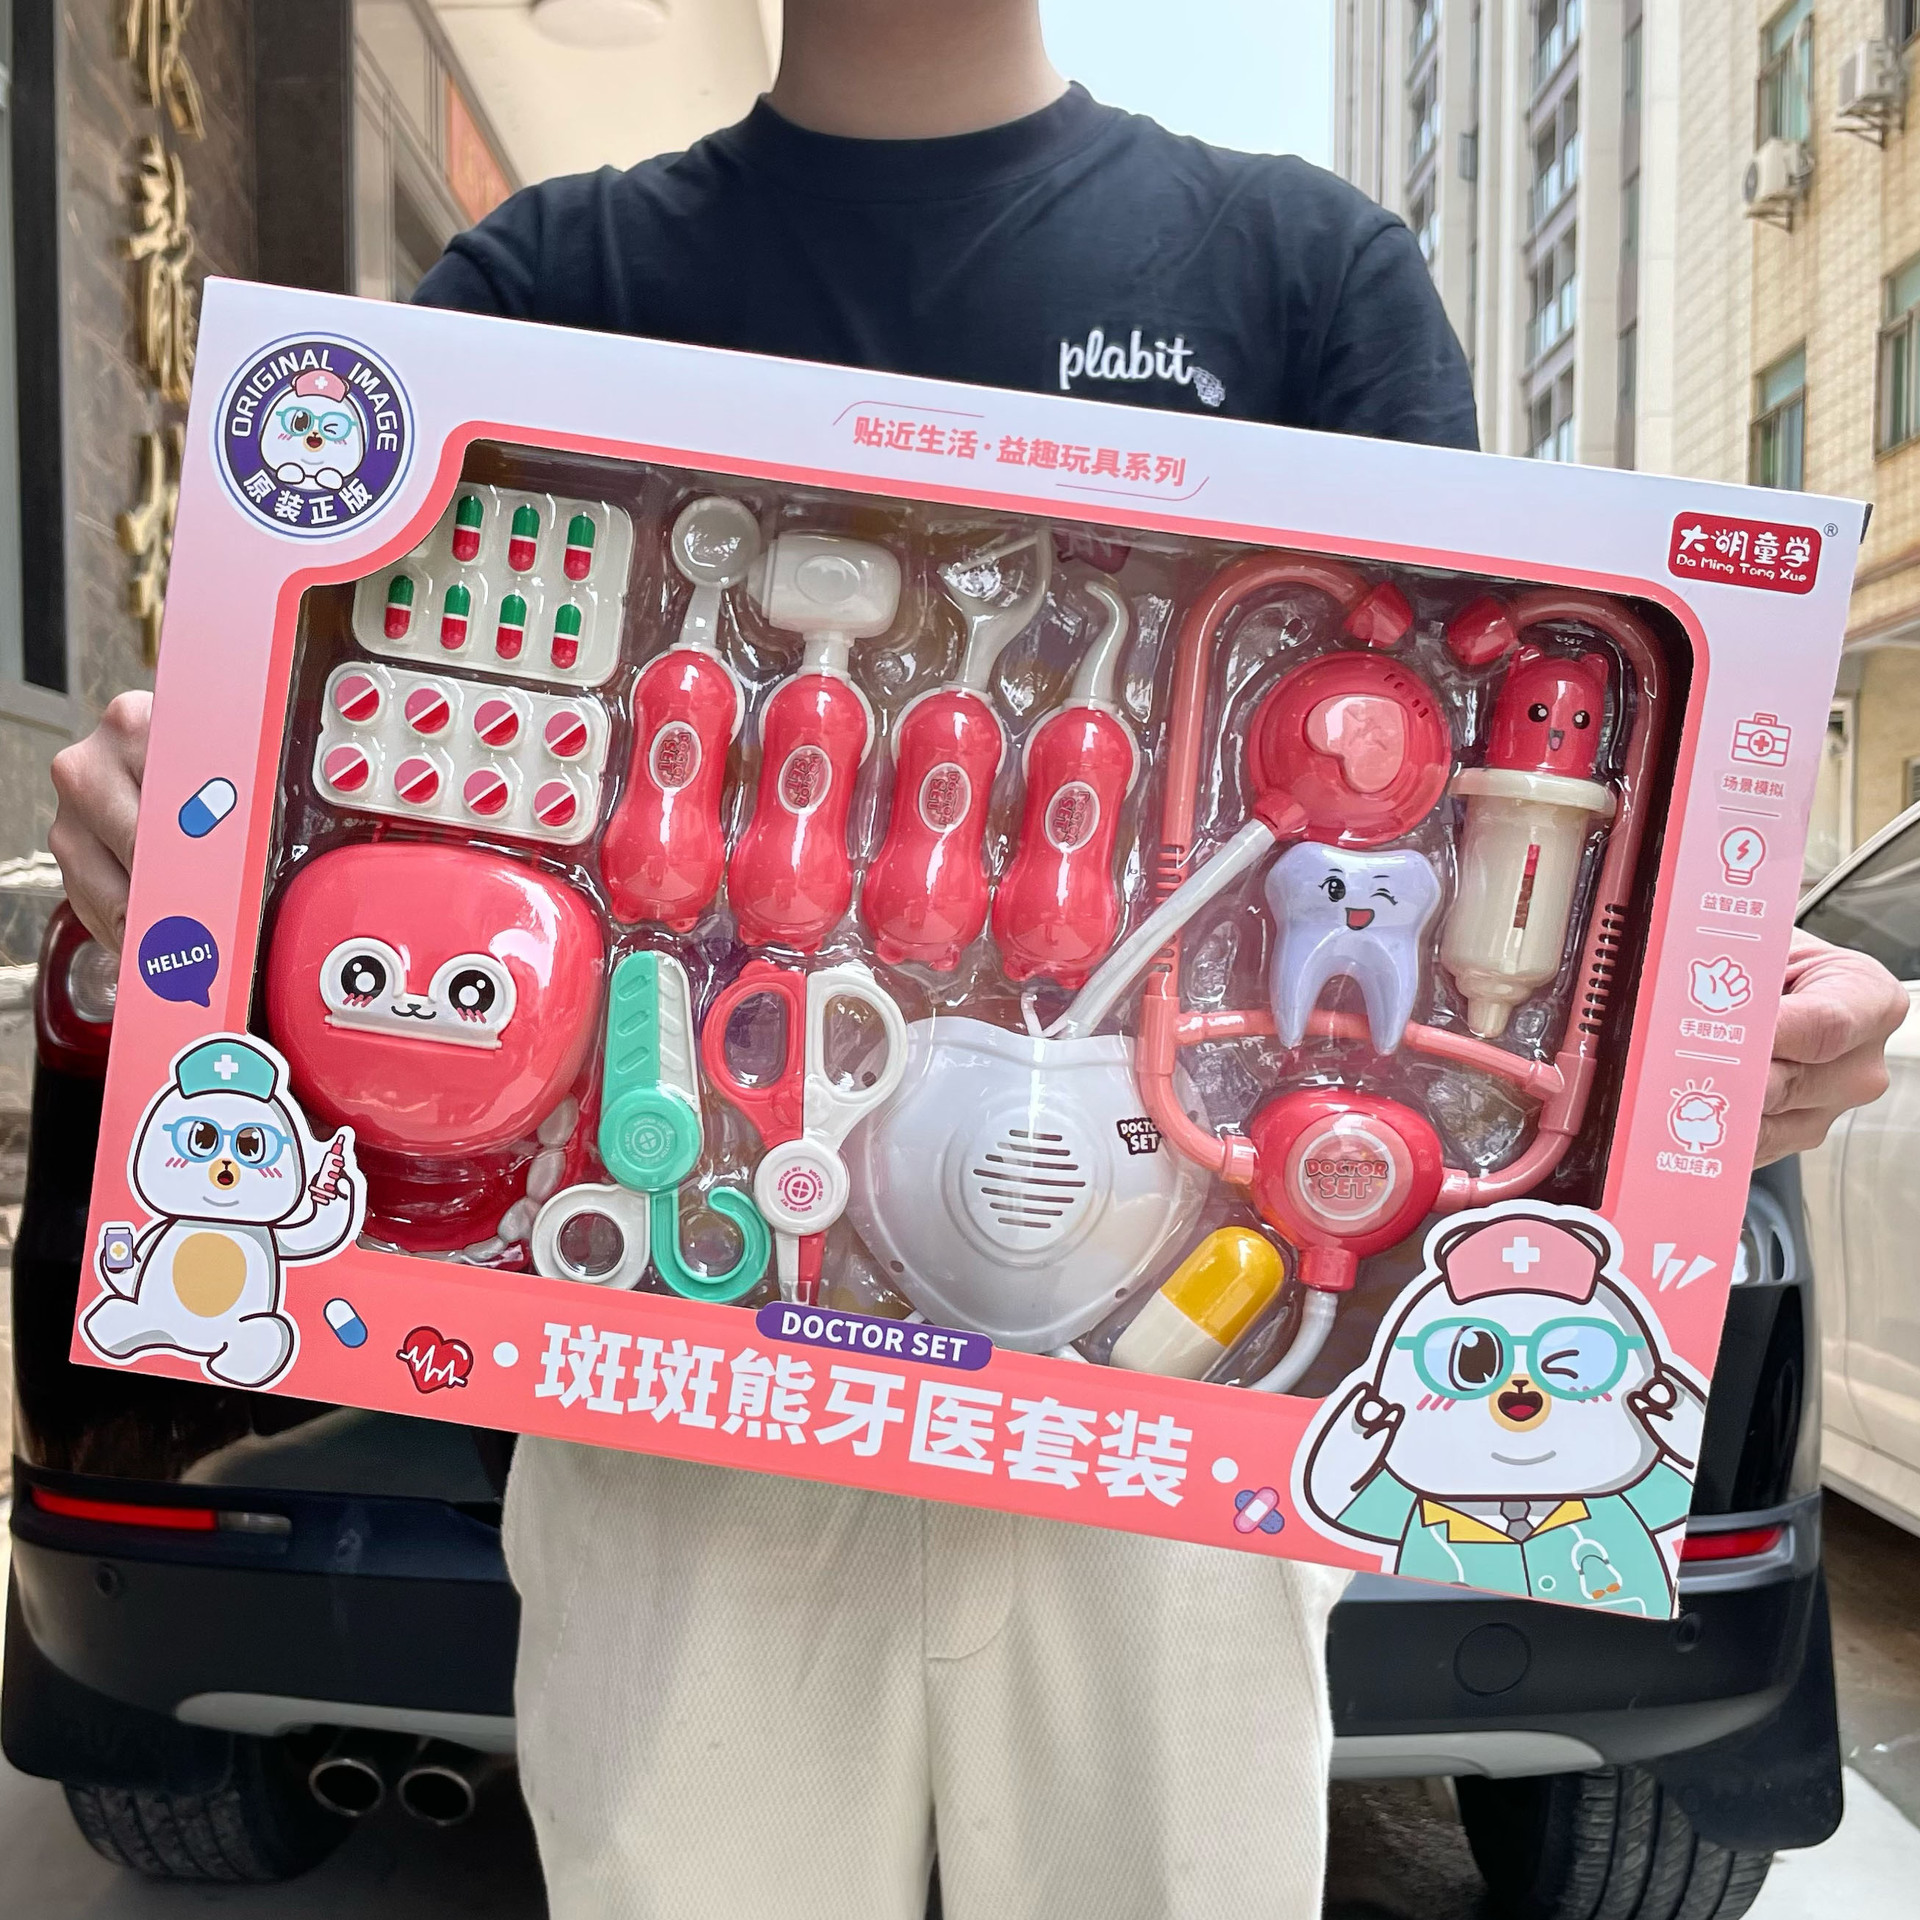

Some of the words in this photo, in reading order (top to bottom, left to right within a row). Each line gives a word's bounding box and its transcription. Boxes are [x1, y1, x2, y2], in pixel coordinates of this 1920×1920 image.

[1059, 330, 1195, 390] plabit
[231, 349, 334, 437] ORIGINAL
[348, 362, 398, 452] IMAGE
[243, 468, 373, 525] 原装正版
[1676, 553, 1697, 567] Da
[1700, 557, 1735, 575] Ming
[1739, 562, 1776, 580] Tong
[1779, 568, 1808, 583] Xue
[1722, 774, 1785, 798] 场景模拟
[1702, 894, 1765, 917] 益智启蒙
[146, 943, 213, 976] HELLO!
[1681, 1019, 1744, 1043] 手眼协调
[1120, 1120, 1158, 1135] DOCTO
[1130, 1134, 1158, 1152] SET
[1304, 1158, 1390, 1180] DOCTOR
[1657, 1152, 1721, 1176] 认知培养
[1317, 1176, 1372, 1200] SET
[781, 1310, 905, 1353] DOCTOR
[910, 1331, 969, 1362] SET
[533, 1321, 1194, 1507] 斑斑熊牙医套装
